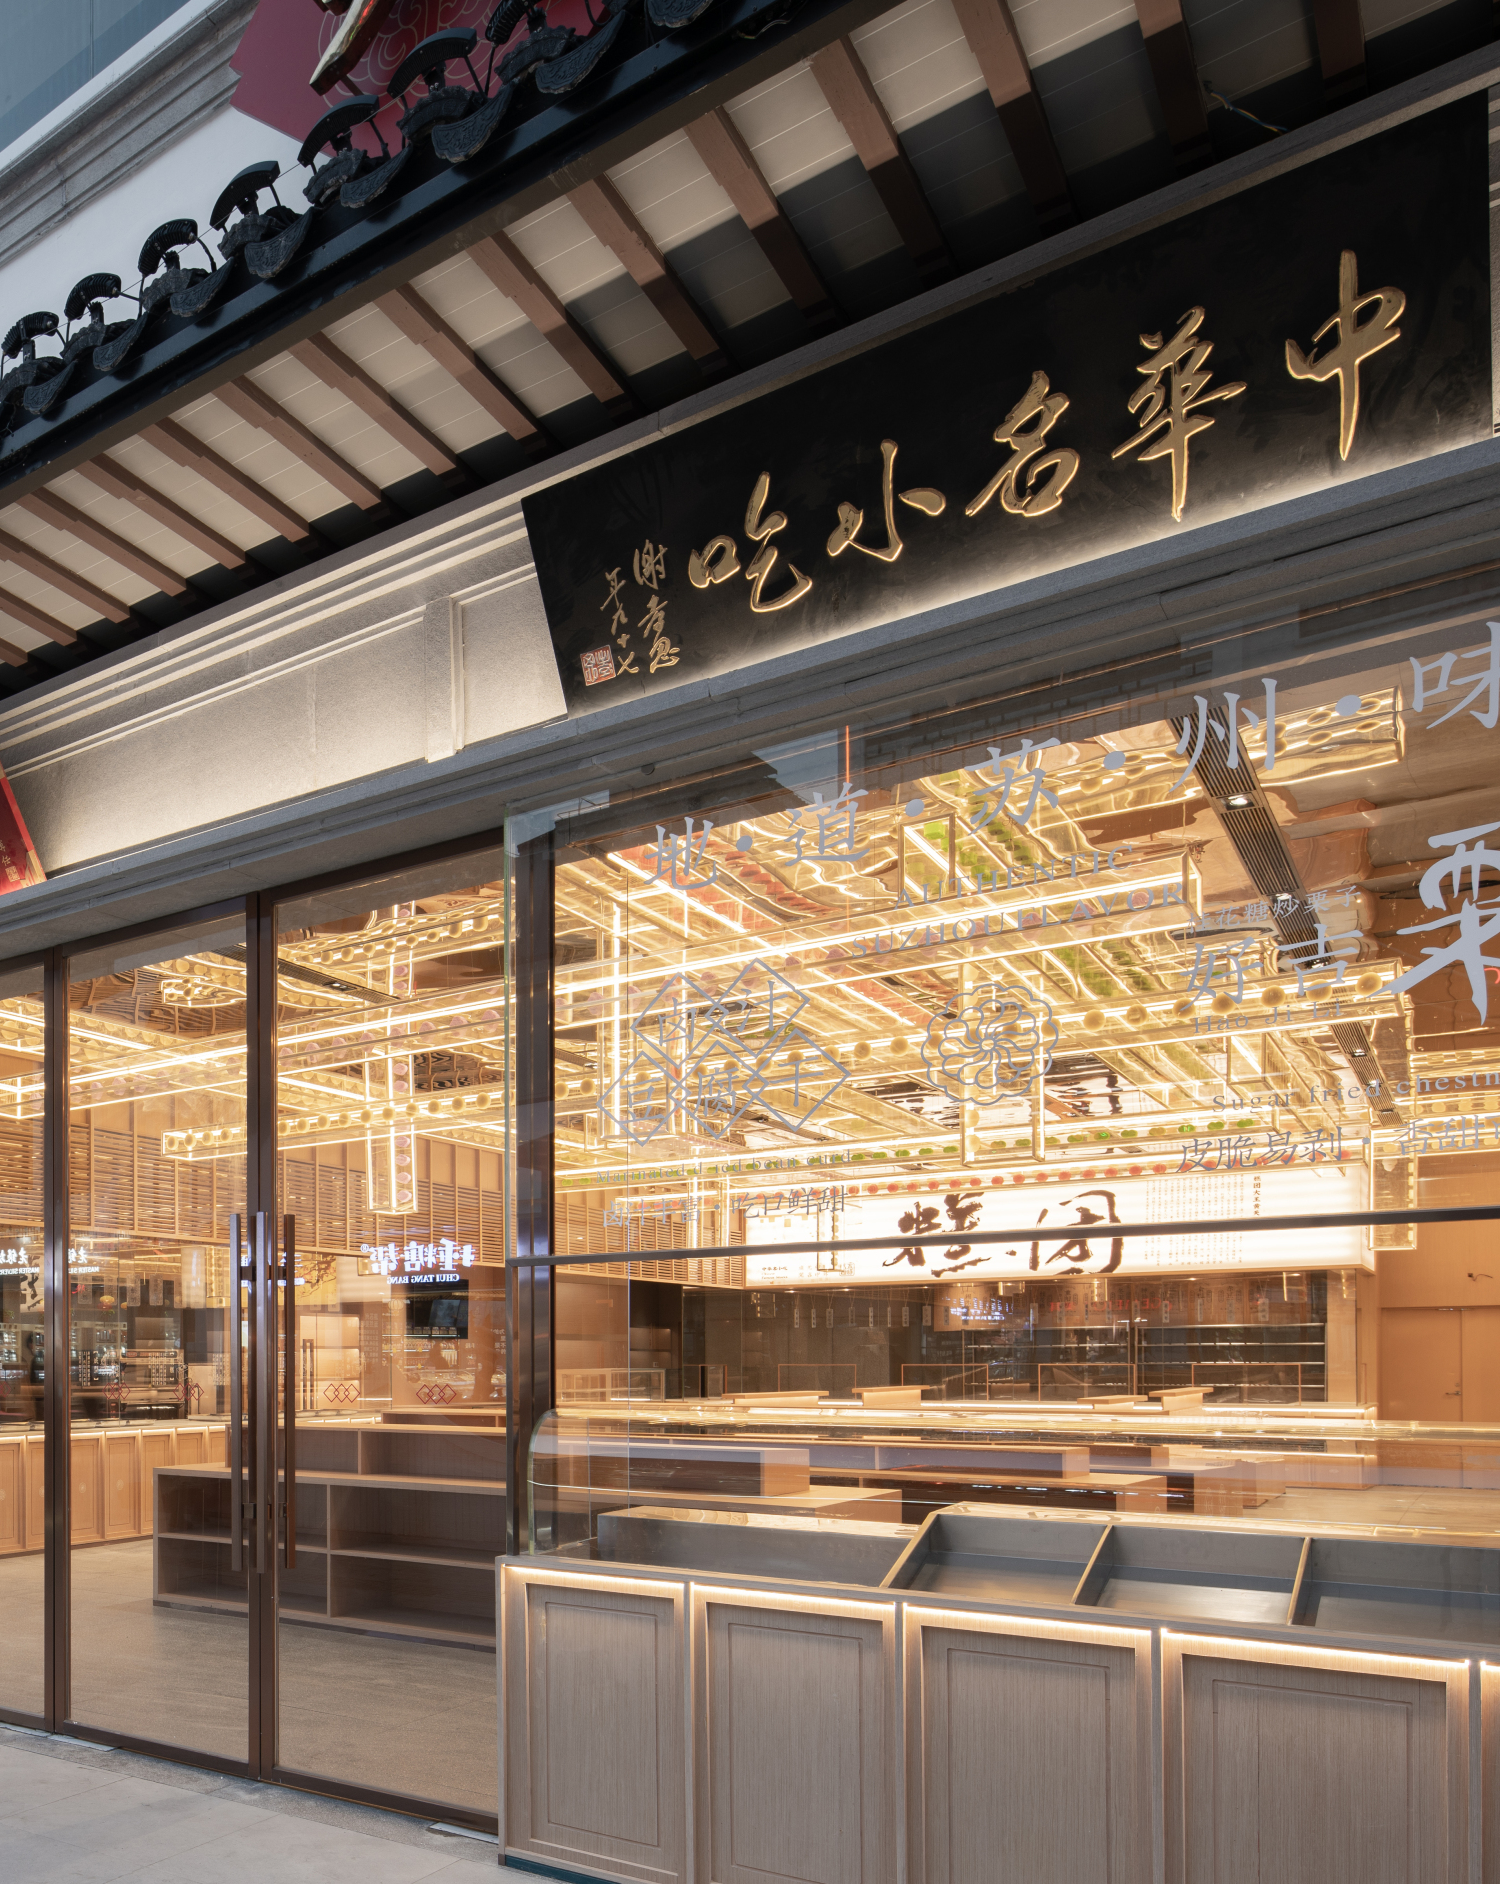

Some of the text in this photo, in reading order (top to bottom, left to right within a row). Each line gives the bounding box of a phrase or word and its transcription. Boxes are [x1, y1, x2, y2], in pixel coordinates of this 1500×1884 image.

[894, 845, 1133, 910] AUTHENTIC
[1193, 997, 1345, 1034] Hao Ji Li
[1212, 1091, 1295, 1114] Sugar
[1308, 1079, 1380, 1103] fried
[596, 1149, 851, 1184] Marinated died bean curd
